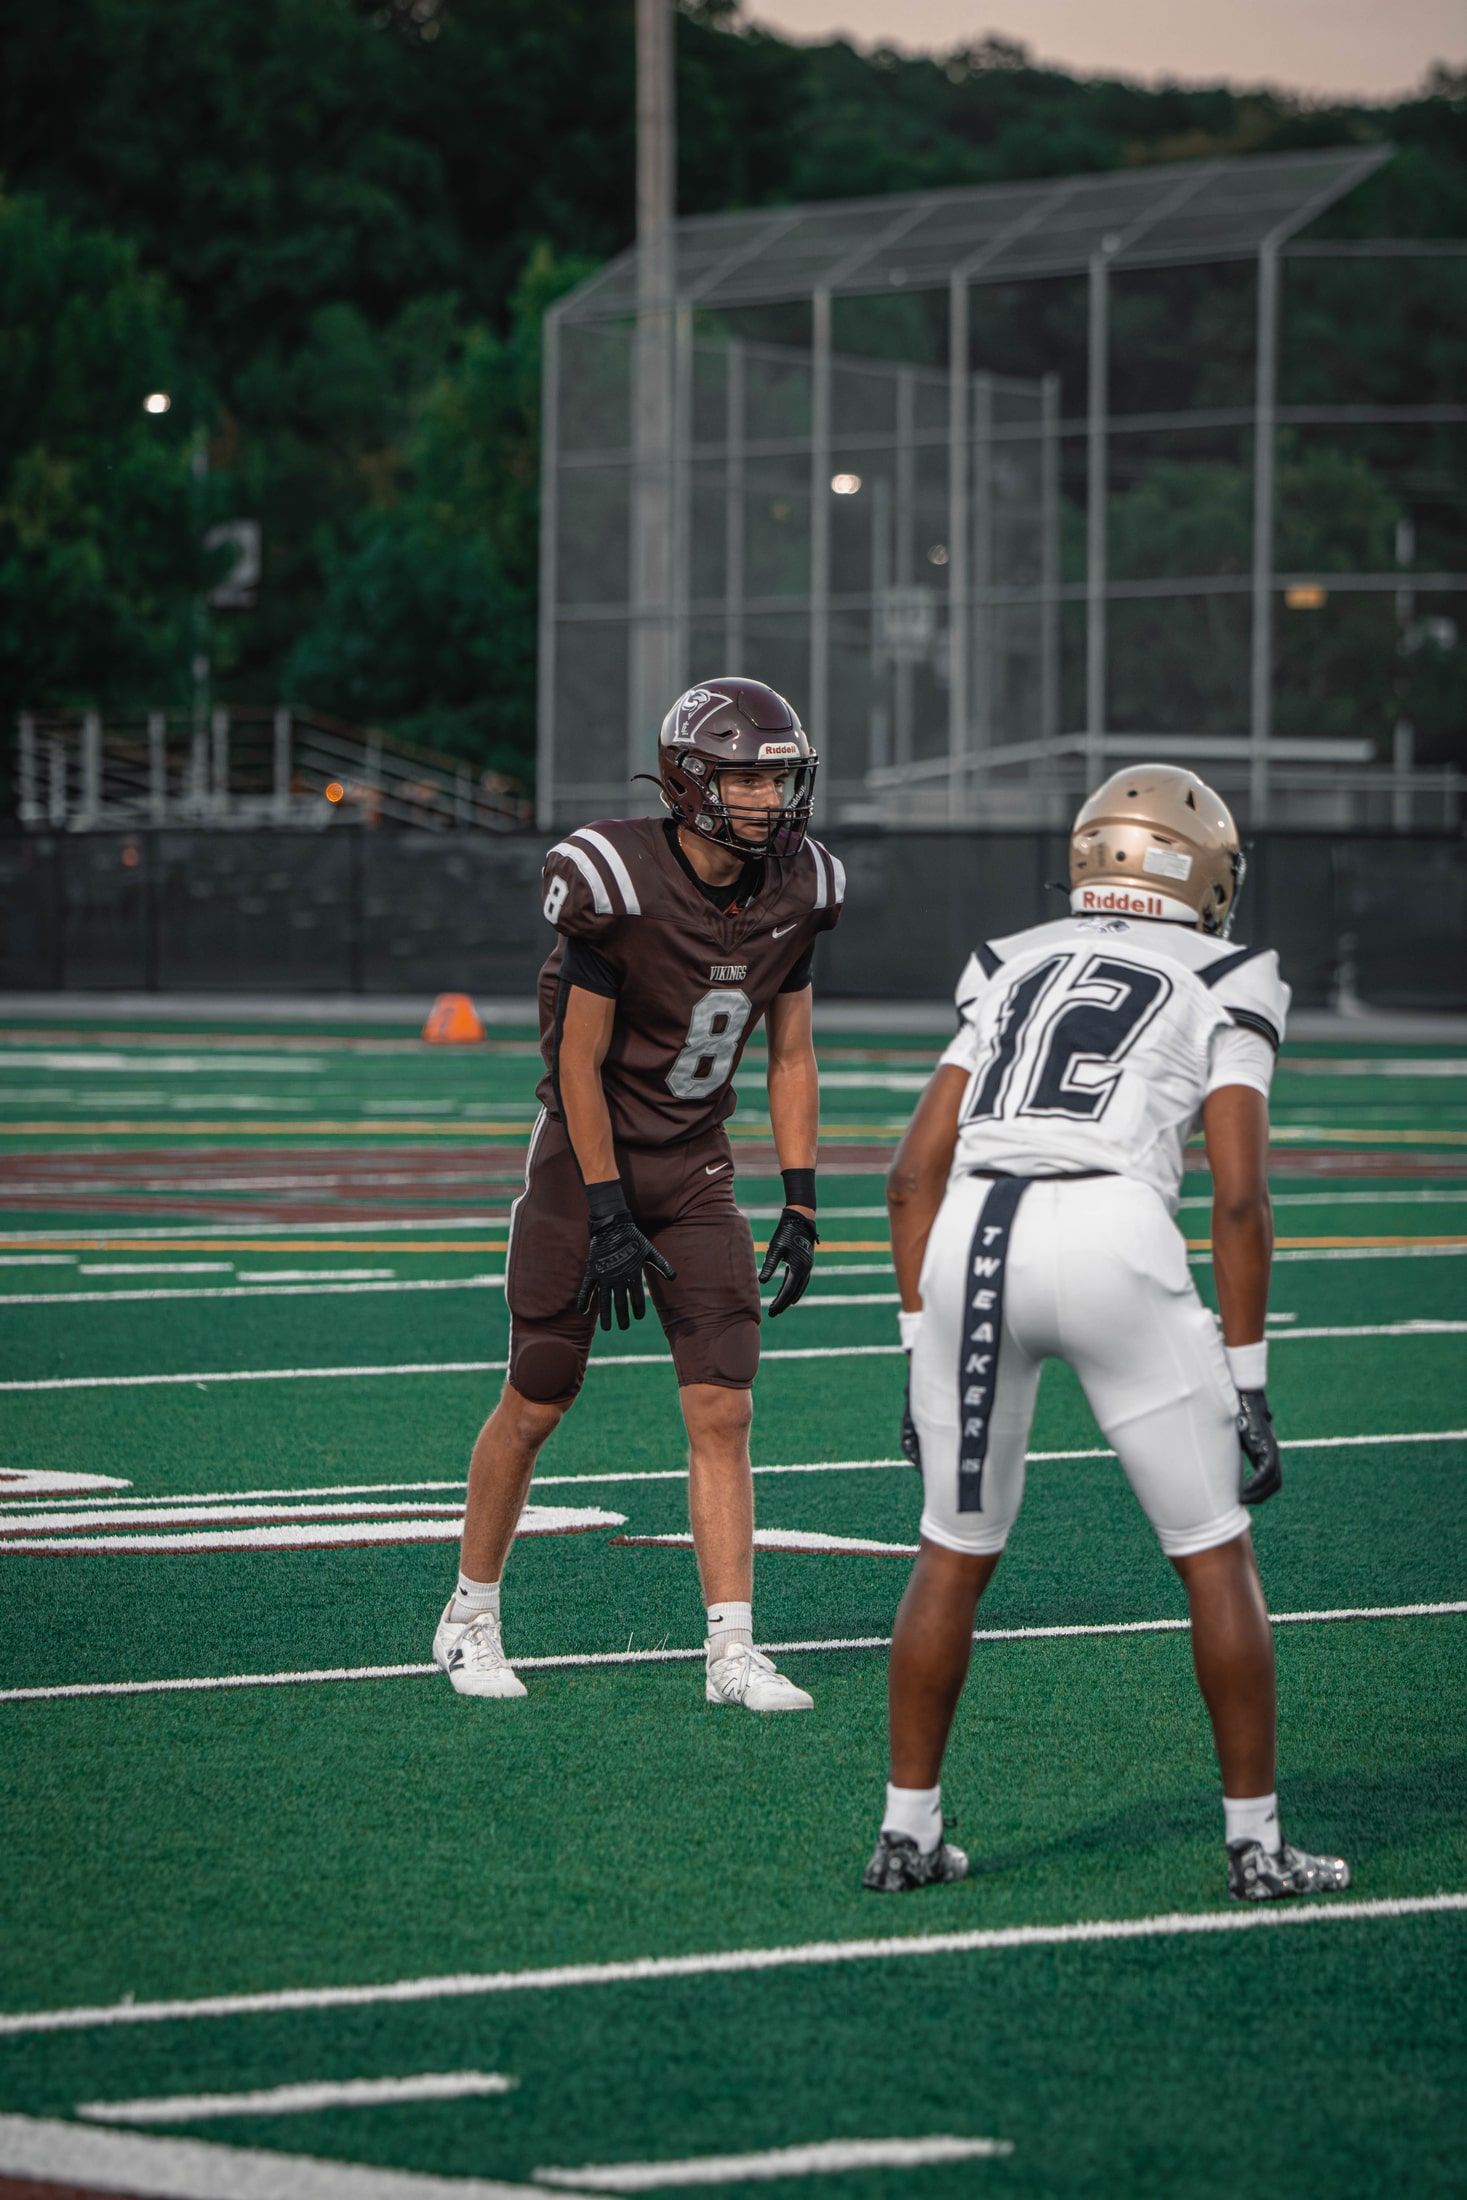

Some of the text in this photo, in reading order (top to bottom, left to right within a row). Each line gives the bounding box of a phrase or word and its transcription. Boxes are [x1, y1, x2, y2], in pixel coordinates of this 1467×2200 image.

[765, 743, 796, 755] Riddell
[543, 875, 569, 925] 8
[1082, 891, 1162, 916] Riddell
[709, 965, 747, 981] VIKINGS
[665, 989, 752, 1100] 8
[959, 953, 1173, 1127] 12
